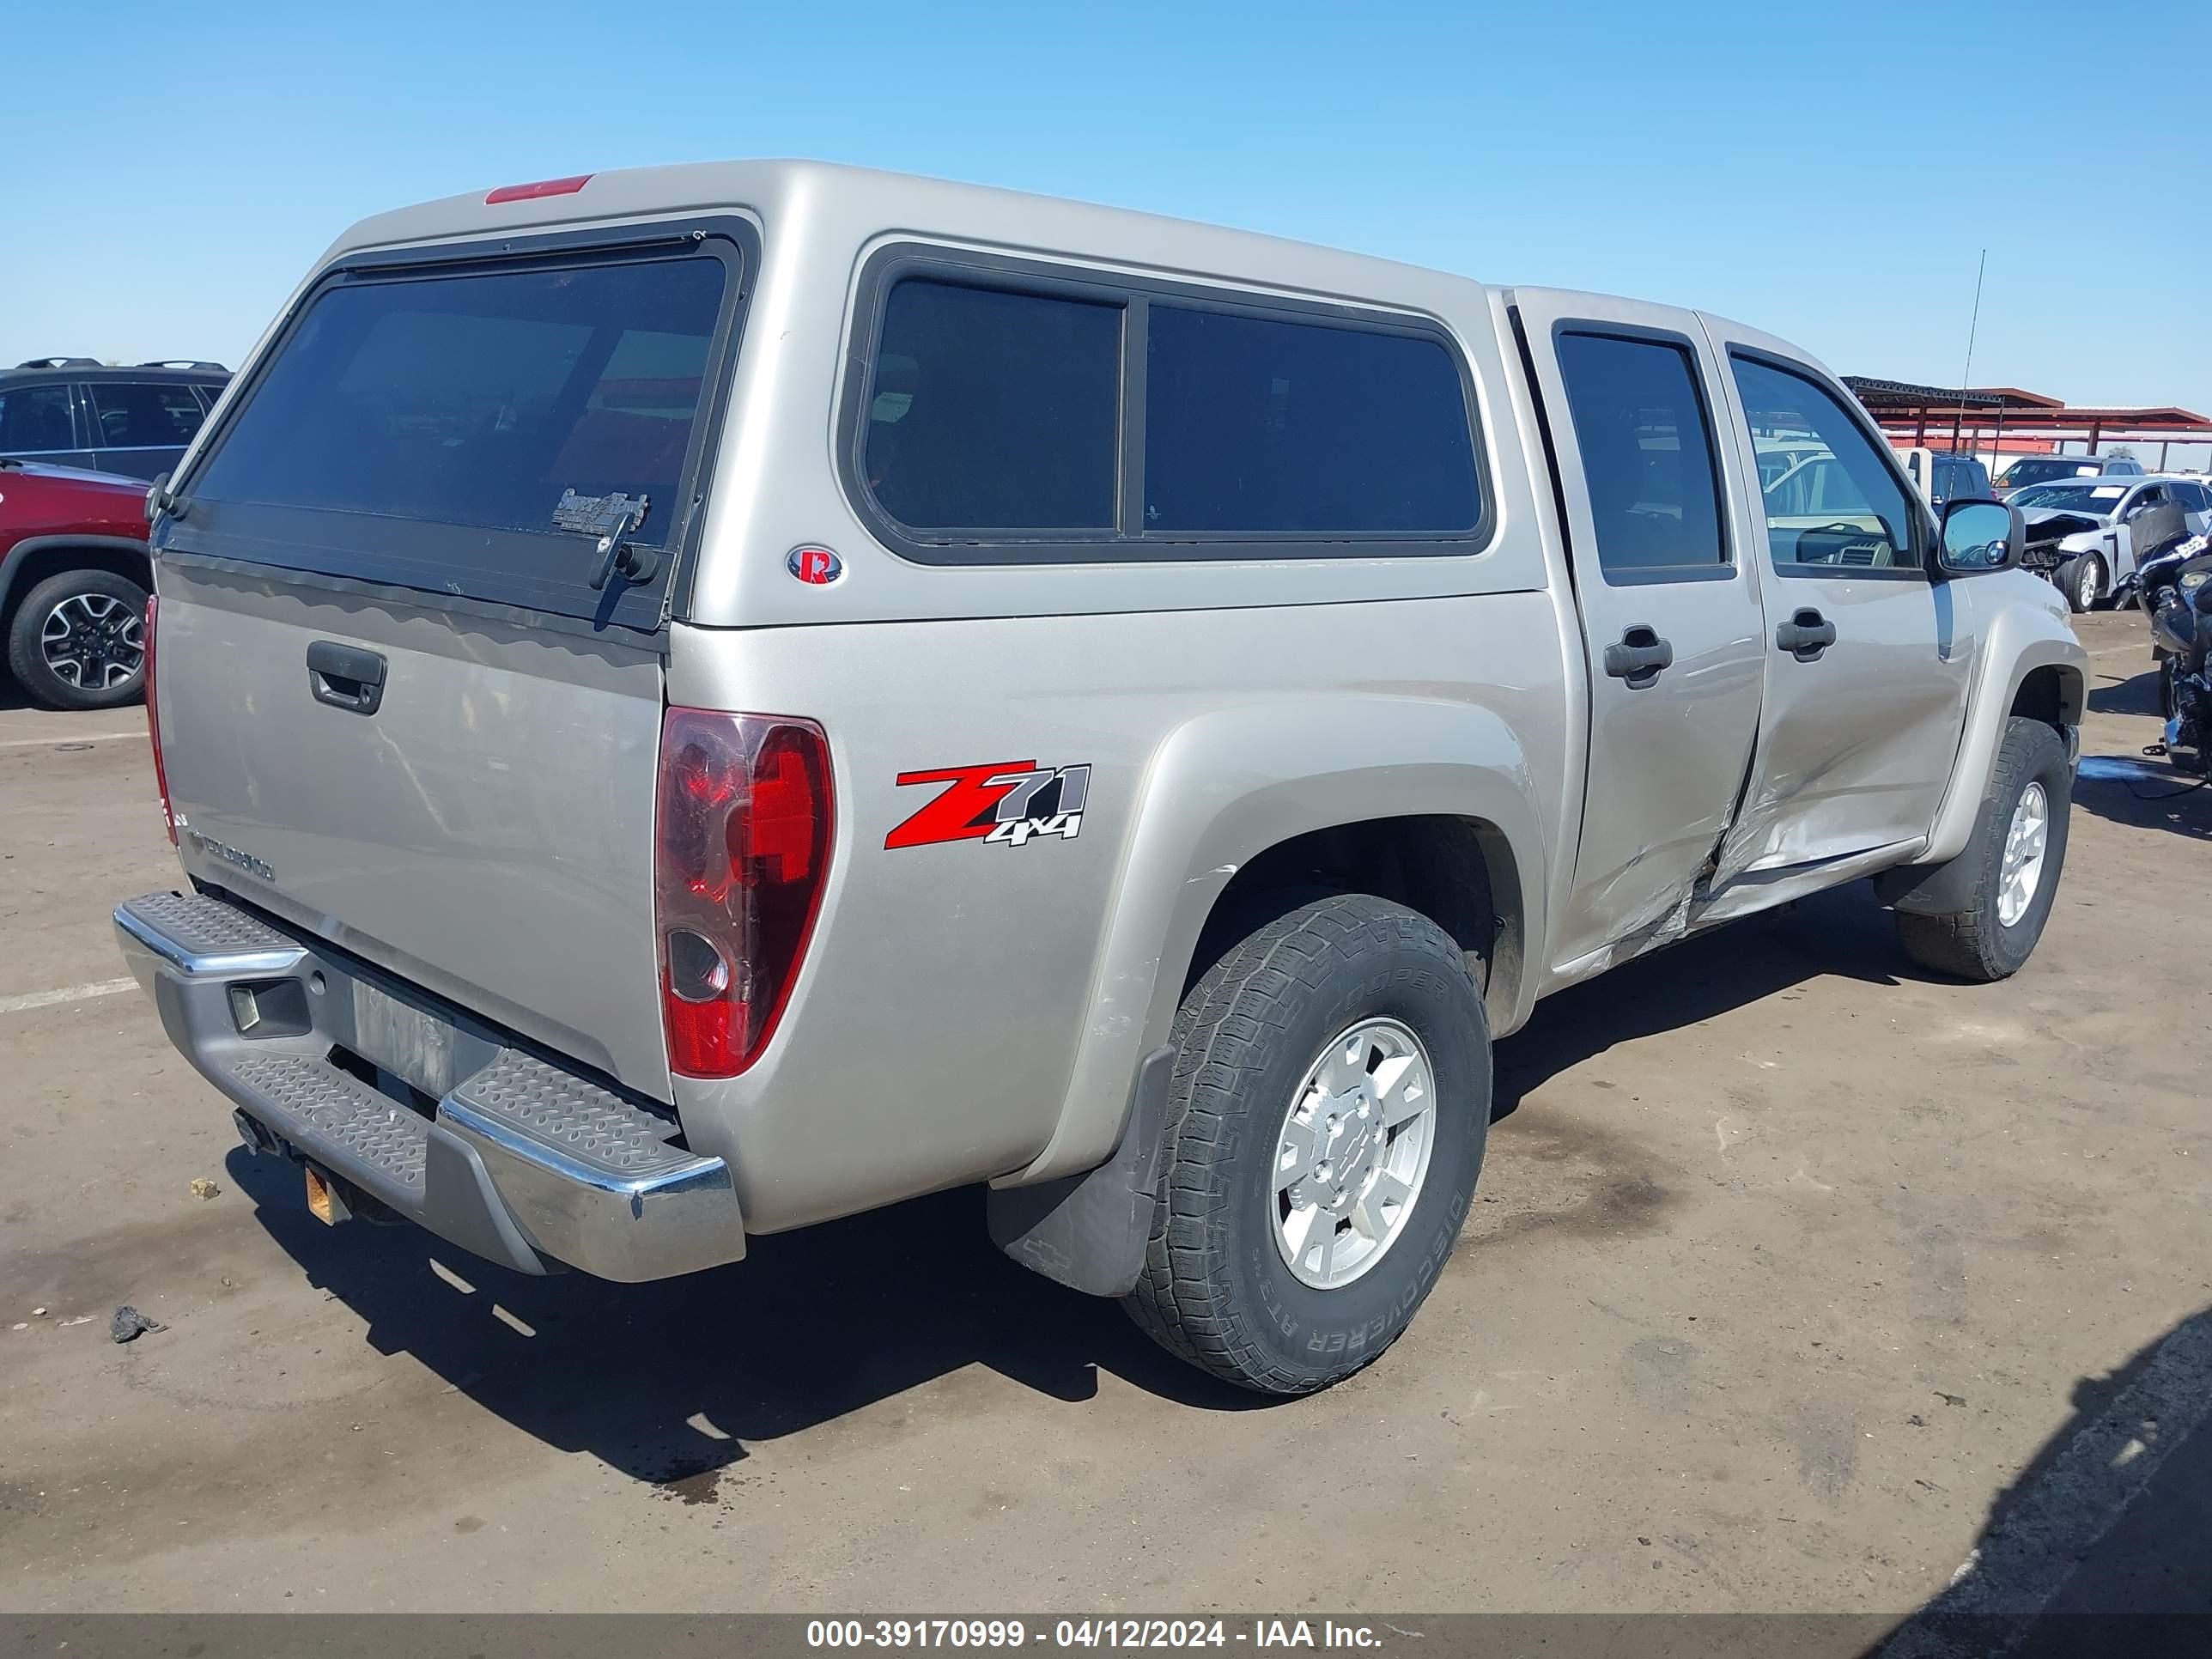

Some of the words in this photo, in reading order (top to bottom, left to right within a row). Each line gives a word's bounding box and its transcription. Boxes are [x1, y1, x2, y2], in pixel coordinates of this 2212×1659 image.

[799, 550, 830, 584] R
[884, 759, 1091, 850] Z71
[983, 813, 1084, 848] 4x4
[1306, 1188, 1468, 1353] DISCOVERER
